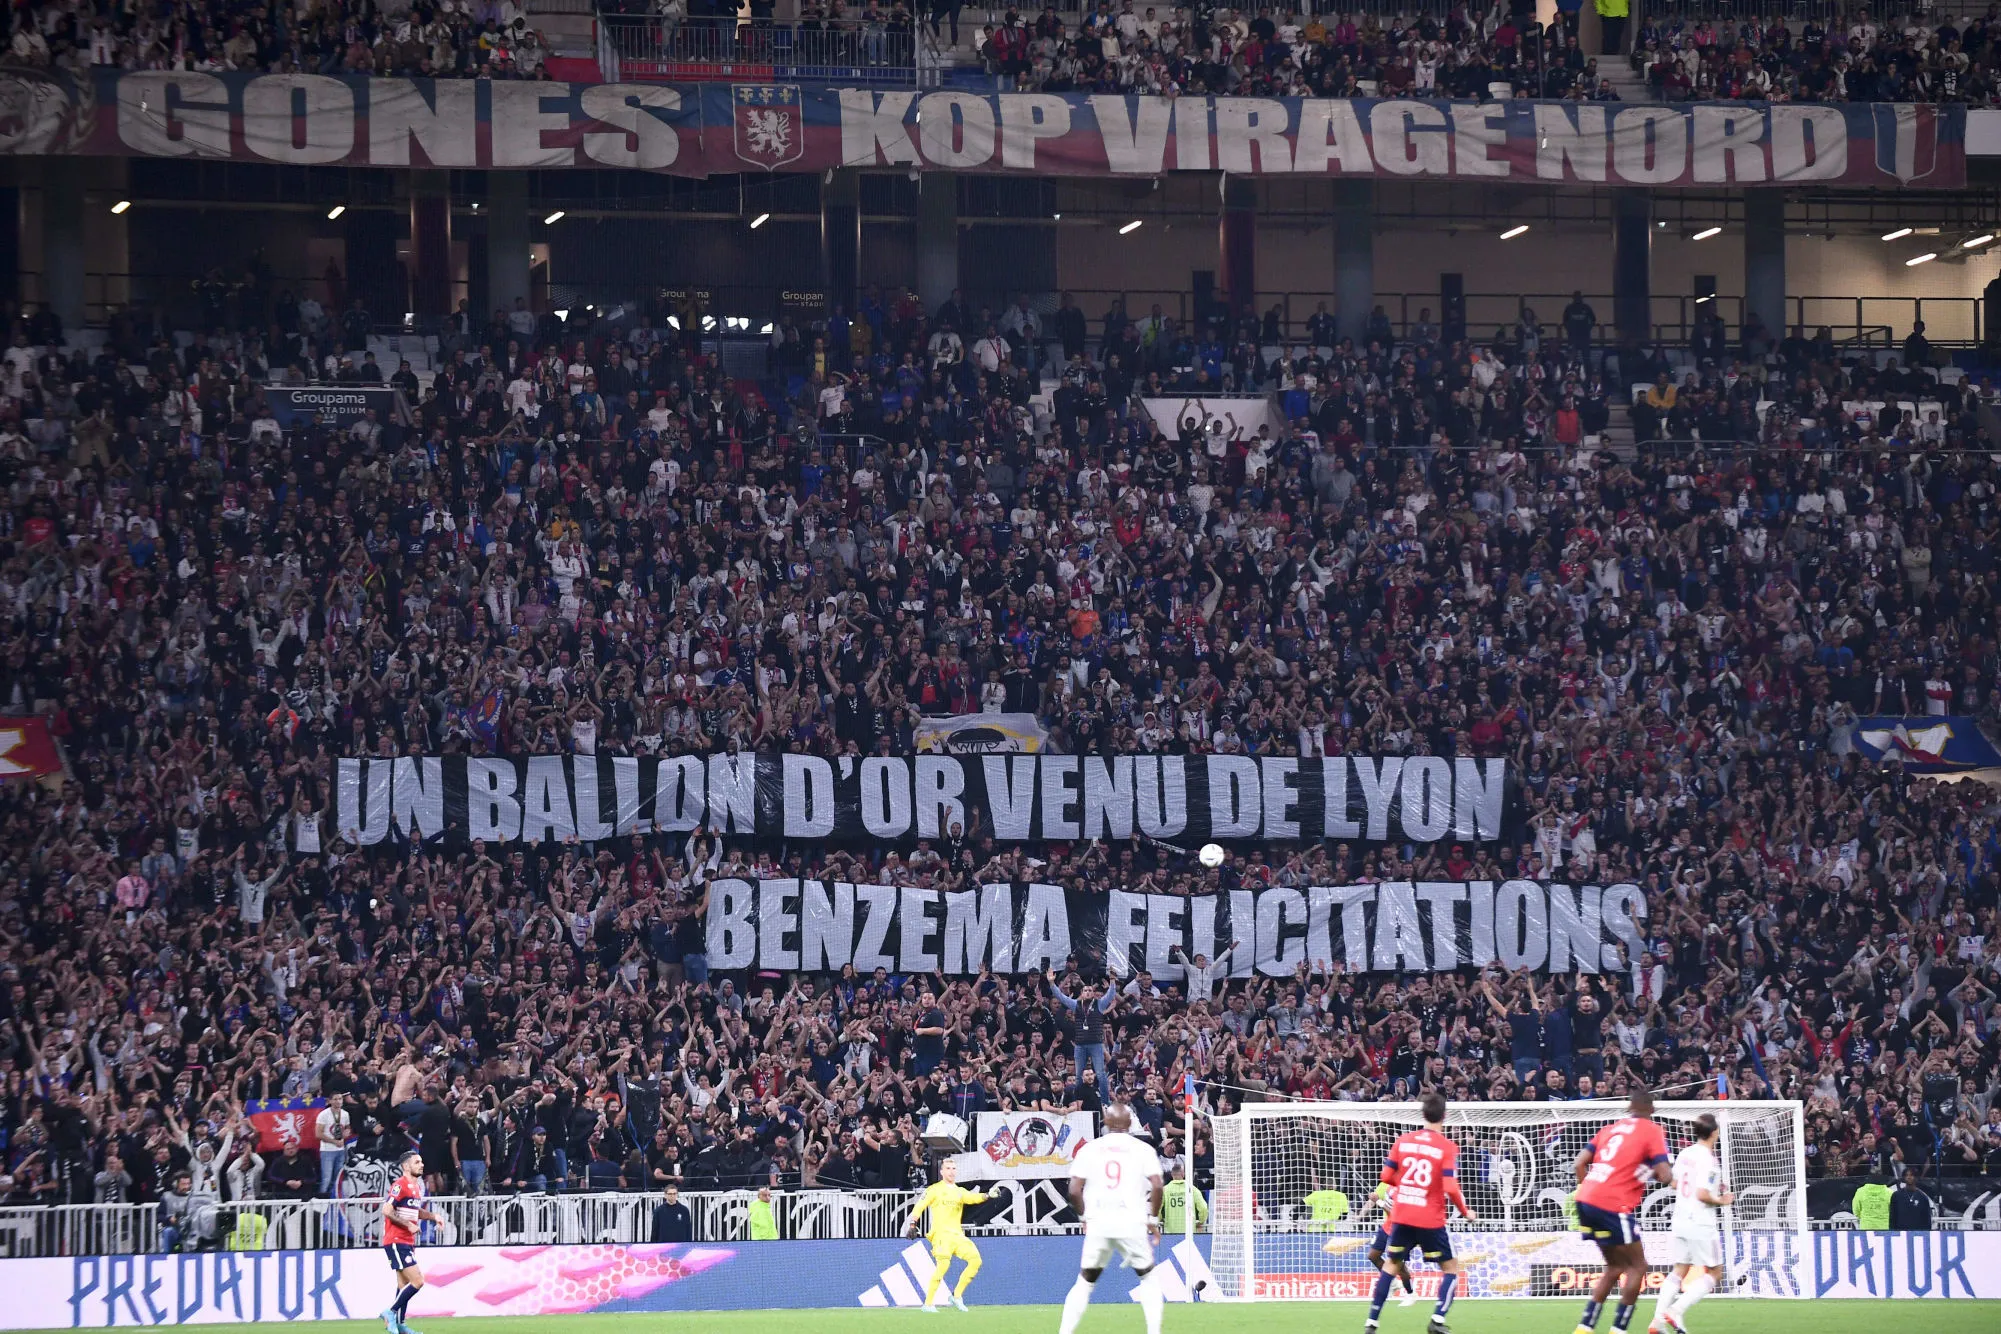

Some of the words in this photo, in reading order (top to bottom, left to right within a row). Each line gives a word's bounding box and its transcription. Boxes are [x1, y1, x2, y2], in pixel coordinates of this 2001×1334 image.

[116, 71, 682, 168] GONES
[838, 87, 1072, 169] KOP
[1090, 94, 1511, 178] VIRAGE
[1535, 104, 1848, 184] NORD
[782, 290, 824, 303] Groupam
[290, 391, 367, 405] Groupama
[319, 407, 366, 415] STADIUM
[337, 755, 444, 846] UN
[466, 751, 756, 842] BALLON
[782, 752, 966, 838] D'OR
[982, 754, 1188, 840] VENU
[1206, 754, 1300, 839] DE
[1322, 755, 1506, 842] LYON
[706, 877, 1073, 974] BENZEMA
[1106, 880, 1648, 980] FELICITATIONS
[1600, 1135, 1624, 1162] 3
[1105, 1160, 1122, 1190] 9
[1400, 1156, 1433, 1187] 28
[68, 1250, 350, 1328] PREDATOR
[1252, 1272, 1359, 1299] Emirates
